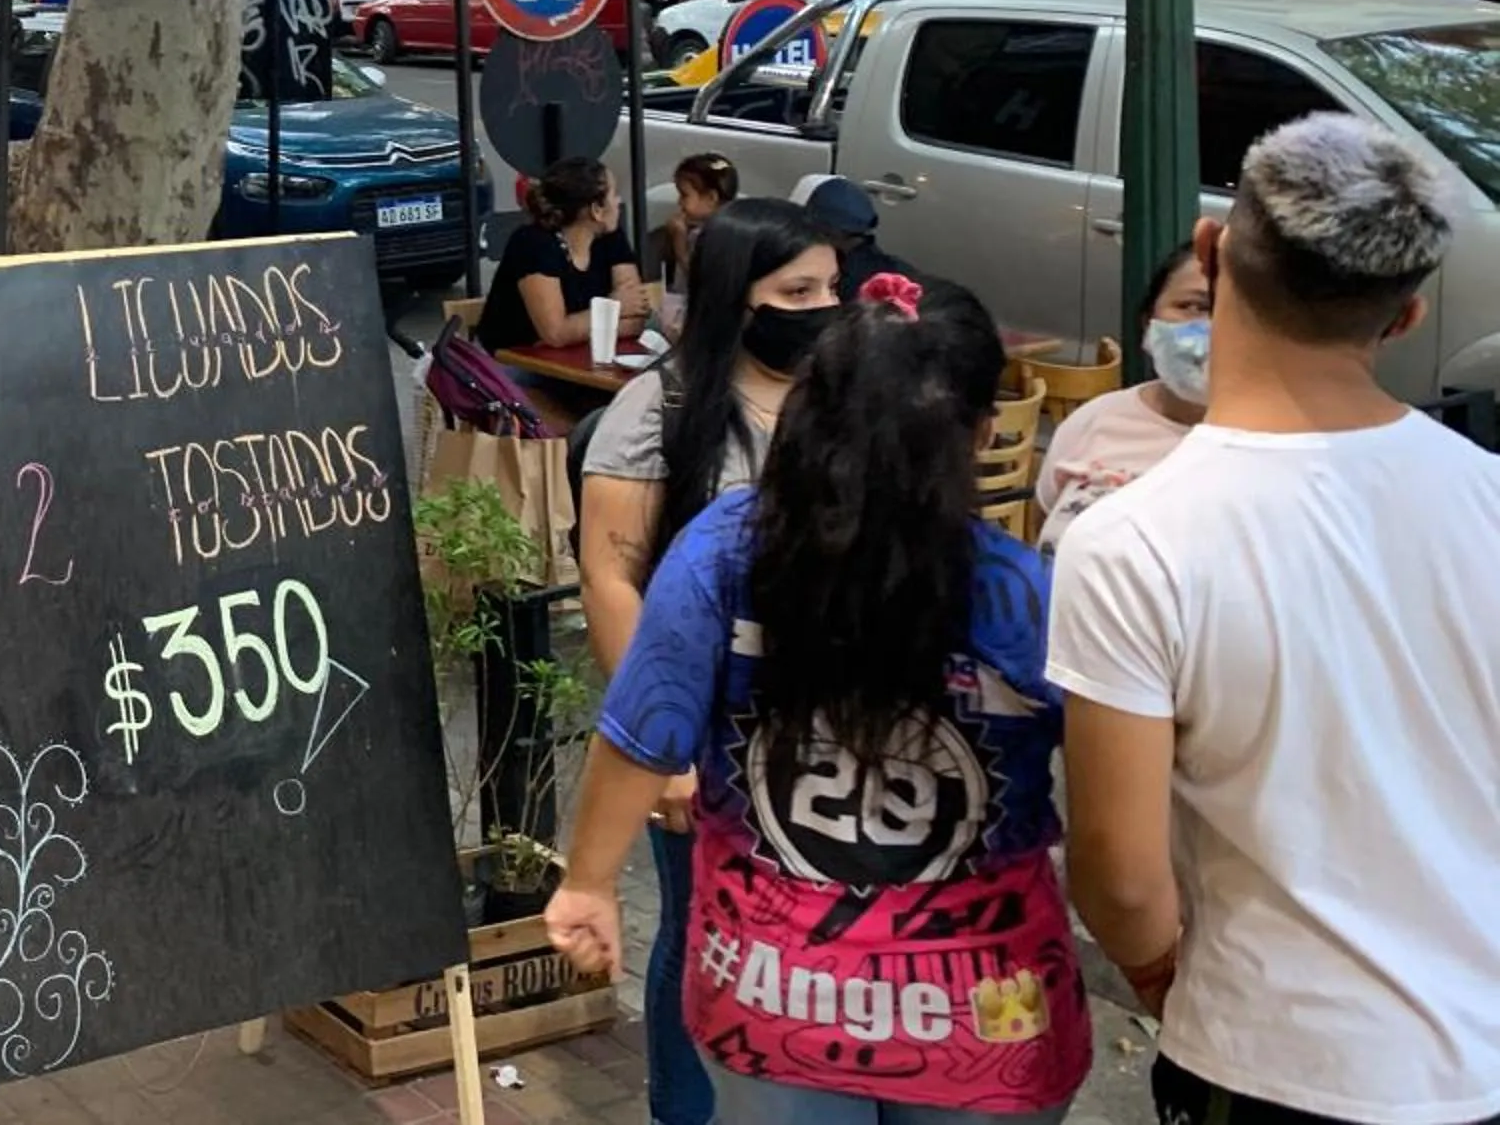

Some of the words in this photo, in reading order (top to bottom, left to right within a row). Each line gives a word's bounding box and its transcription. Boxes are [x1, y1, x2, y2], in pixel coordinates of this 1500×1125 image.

[77, 263, 343, 402] LICUADOS
[15, 461, 74, 587] 2
[144, 425, 392, 566] TOSTADOS
[701, 931, 953, 1043] #Ange
